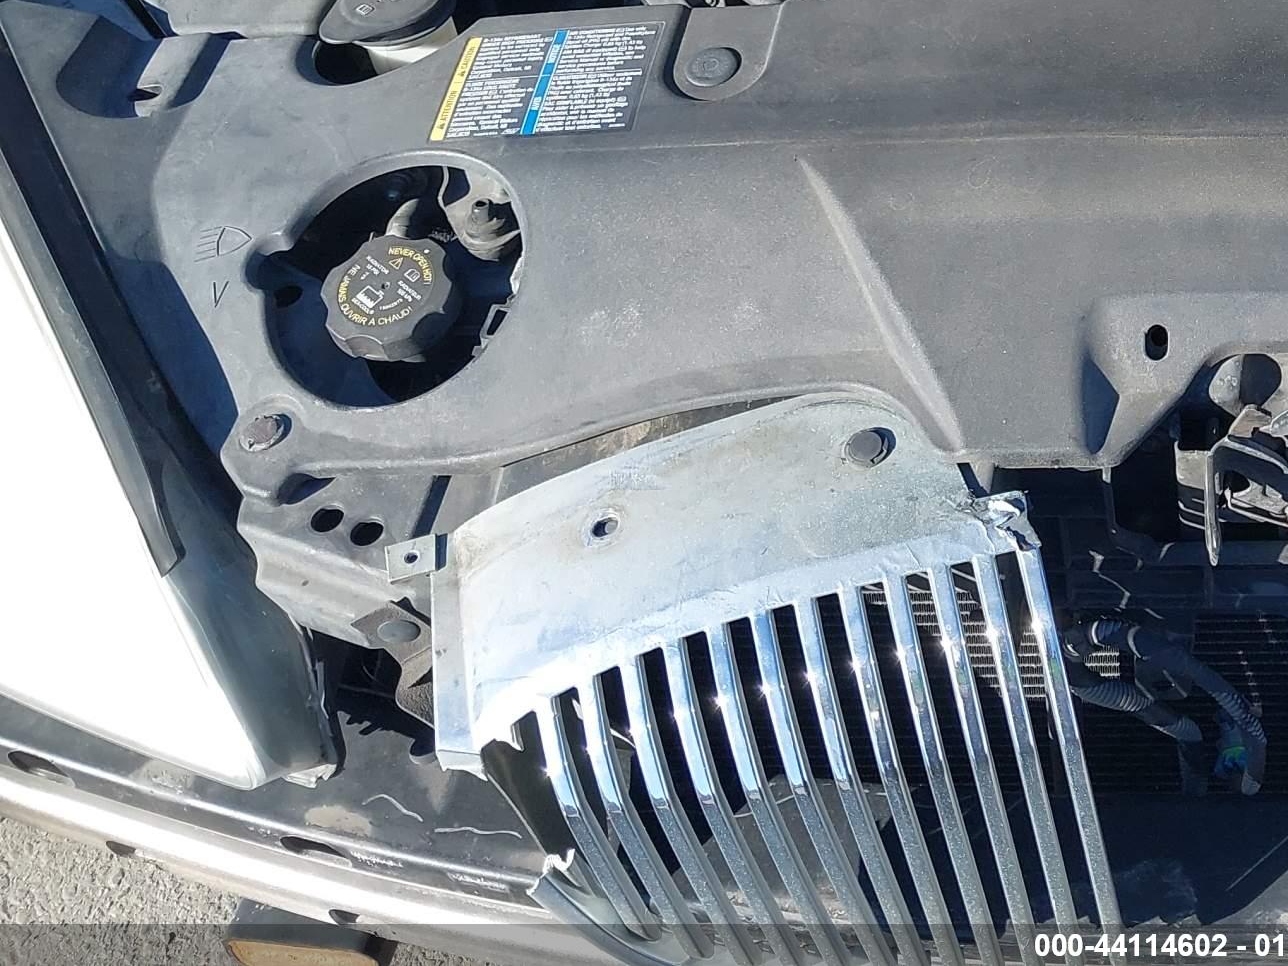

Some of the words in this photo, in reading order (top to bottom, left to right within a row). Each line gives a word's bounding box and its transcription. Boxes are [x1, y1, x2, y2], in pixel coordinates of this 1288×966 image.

[441, 90, 457, 119] ATTENTION
[350, 264, 361, 276] NE
[388, 247, 414, 258] NEVER
[413, 254, 429, 270] OPEN
[338, 277, 351, 306] JAMAIS
[341, 304, 366, 325] OUVRIR
